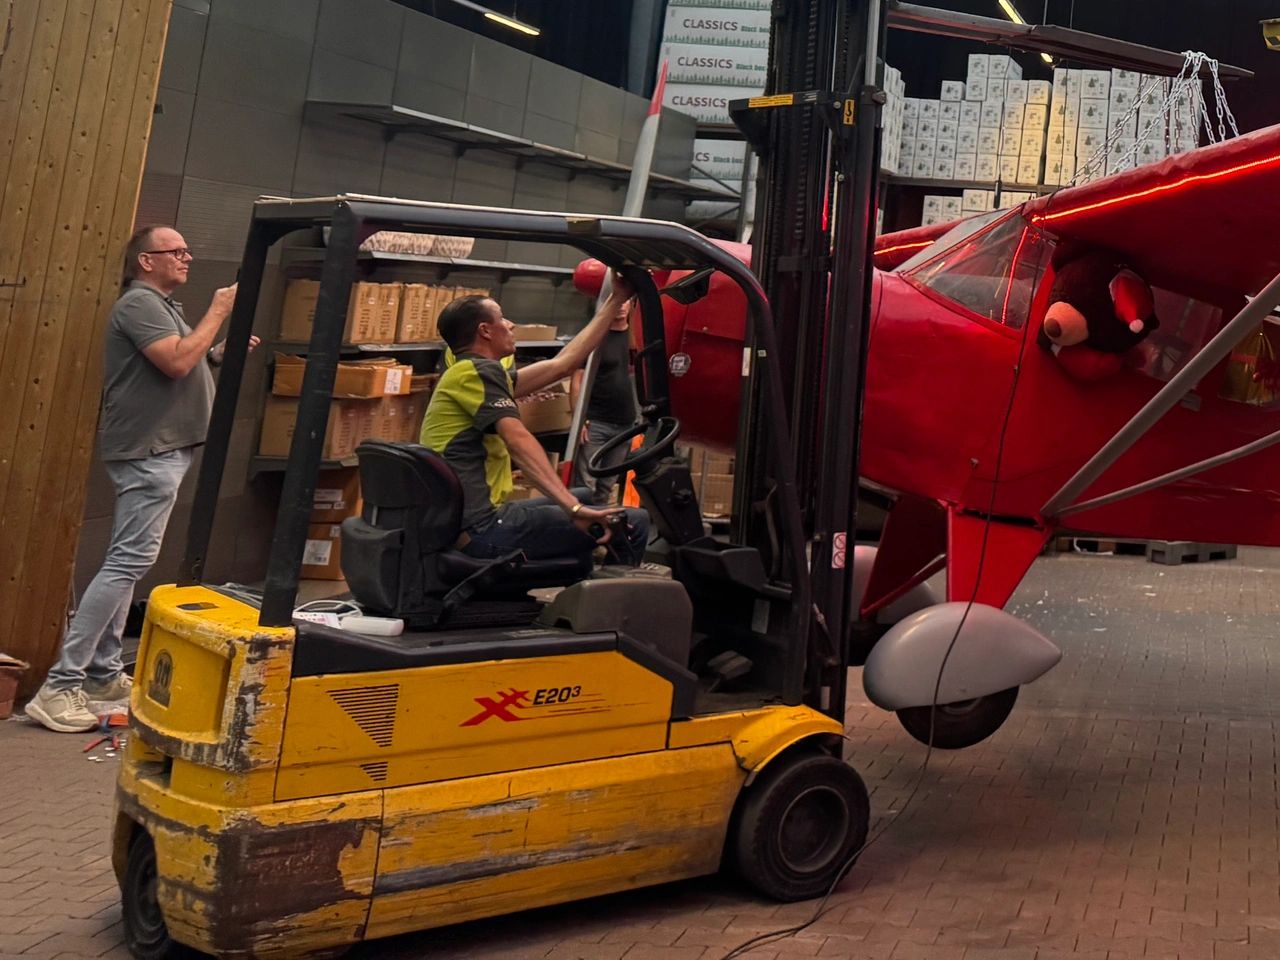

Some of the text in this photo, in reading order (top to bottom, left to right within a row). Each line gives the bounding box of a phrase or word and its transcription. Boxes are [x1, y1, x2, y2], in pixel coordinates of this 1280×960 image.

[683, 19, 738, 31] CLASSICS
[677, 56, 733, 69] CLASSICS
[672, 95, 727, 108] CLASSICS
